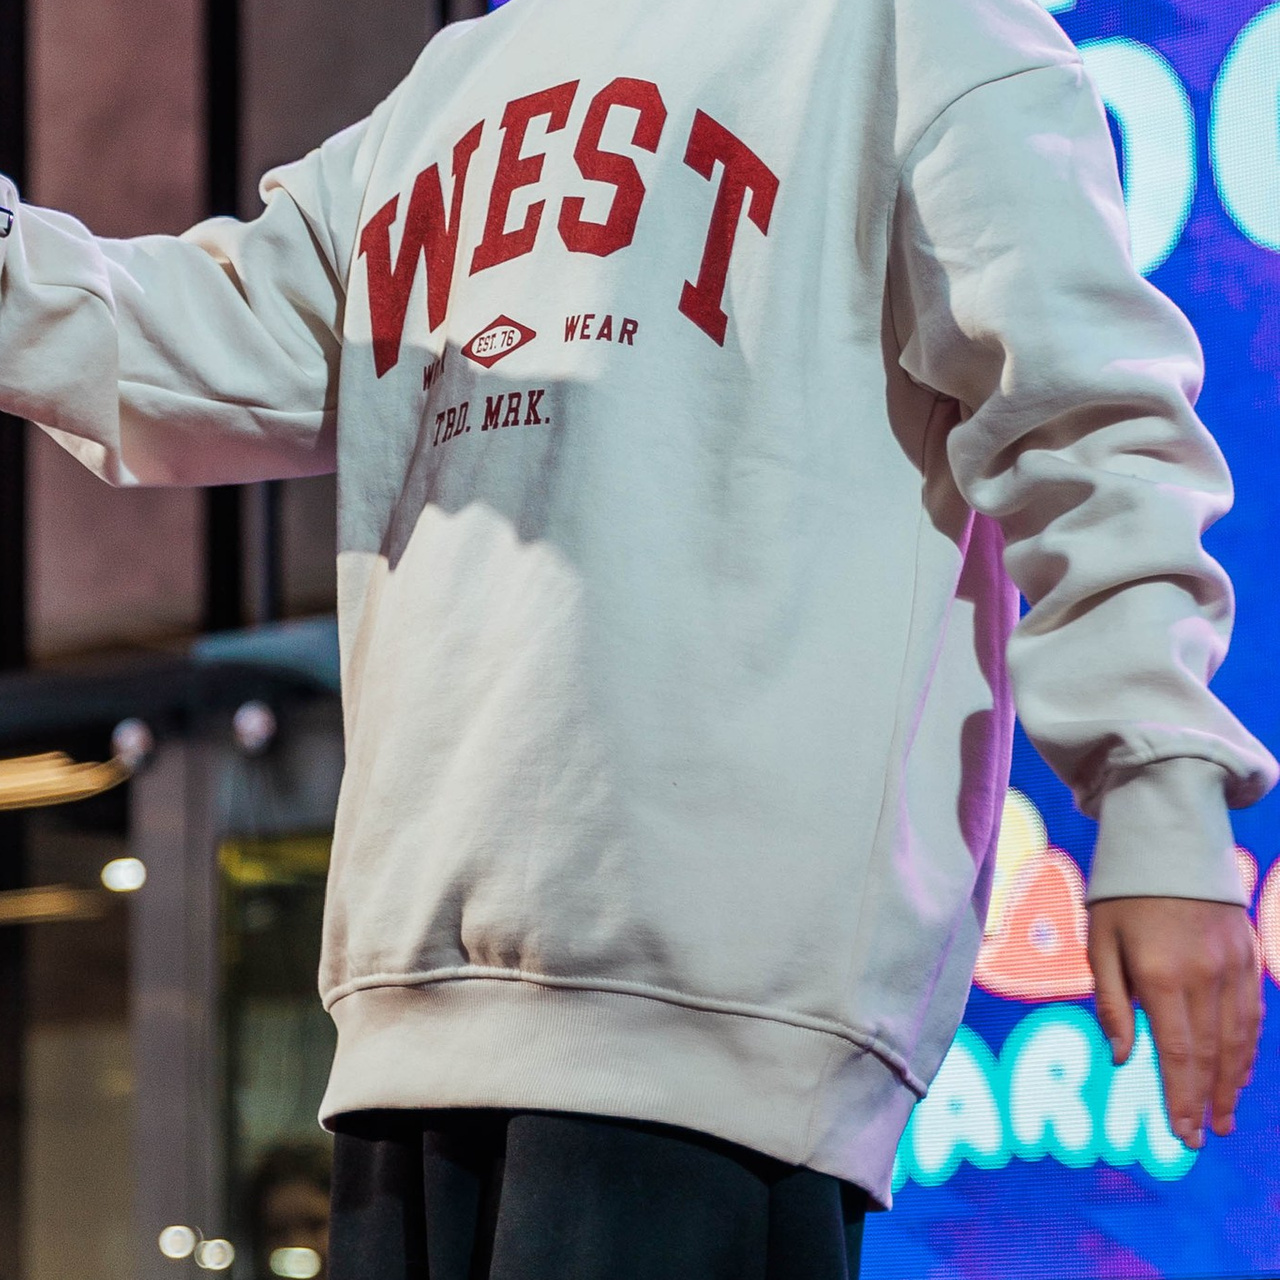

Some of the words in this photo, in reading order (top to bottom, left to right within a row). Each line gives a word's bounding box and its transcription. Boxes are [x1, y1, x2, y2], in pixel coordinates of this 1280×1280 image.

[357, 77, 780, 379] WEST
[475, 332, 497, 354] EST.
[500, 329, 515, 348] 76
[564, 314, 638, 345] WEAR
[433, 401, 471, 447] TRD.
[481, 389, 550, 431] MRK.
